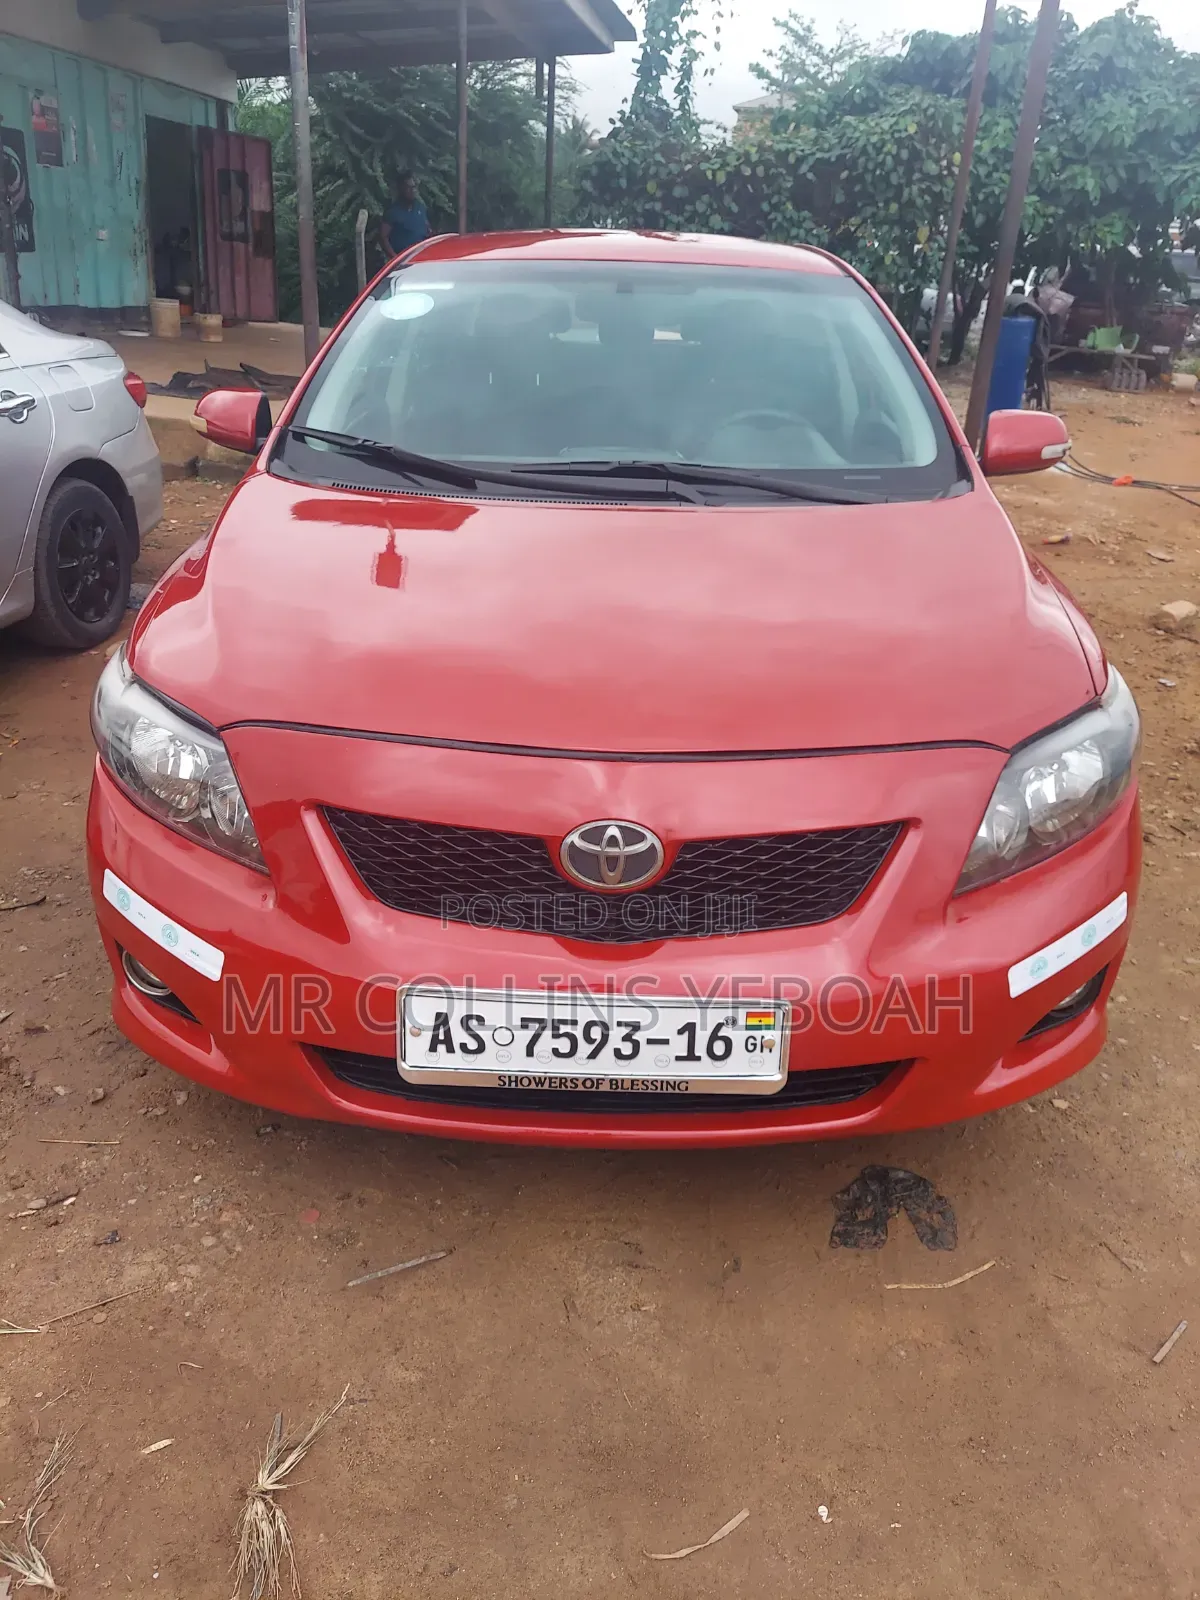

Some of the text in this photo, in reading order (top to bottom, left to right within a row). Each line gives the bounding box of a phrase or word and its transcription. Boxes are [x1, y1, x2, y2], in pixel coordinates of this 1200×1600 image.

[428, 1011, 733, 1062] AS 7593-16
[497, 1075, 689, 1092] SHOWERS OF BLESSING
